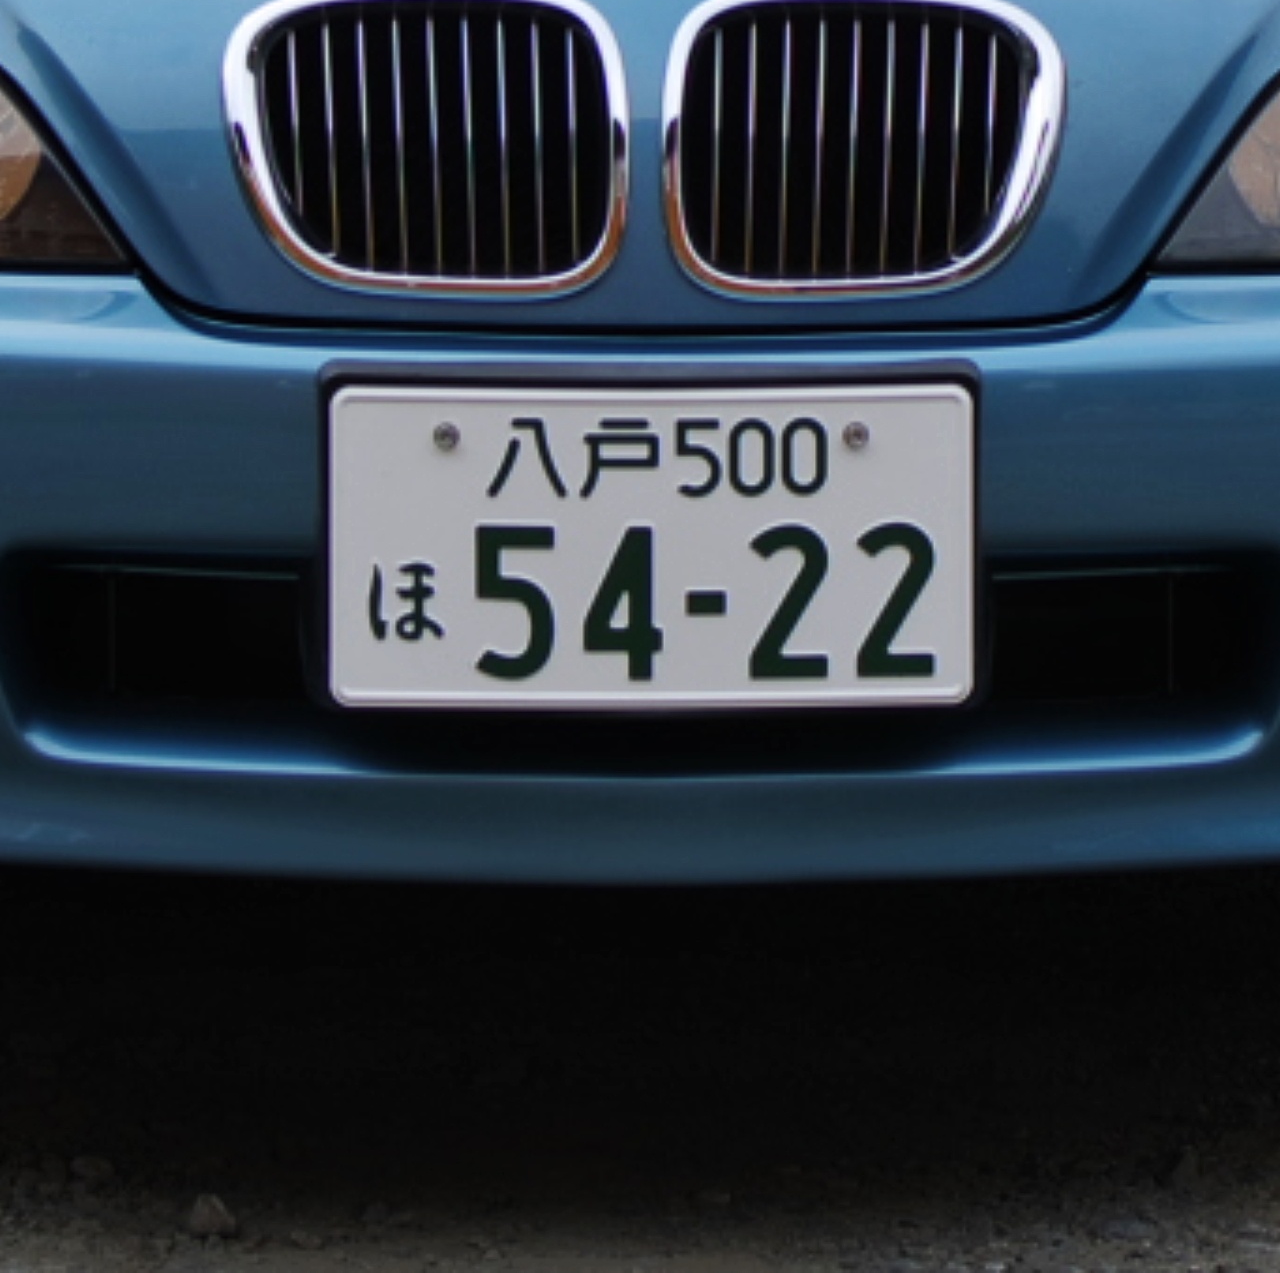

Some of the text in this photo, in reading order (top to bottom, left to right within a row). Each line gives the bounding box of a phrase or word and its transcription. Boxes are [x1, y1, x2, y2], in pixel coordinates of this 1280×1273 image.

[486, 417, 828, 499] 八戸500
[368, 522, 935, 682] ほ 54-22
